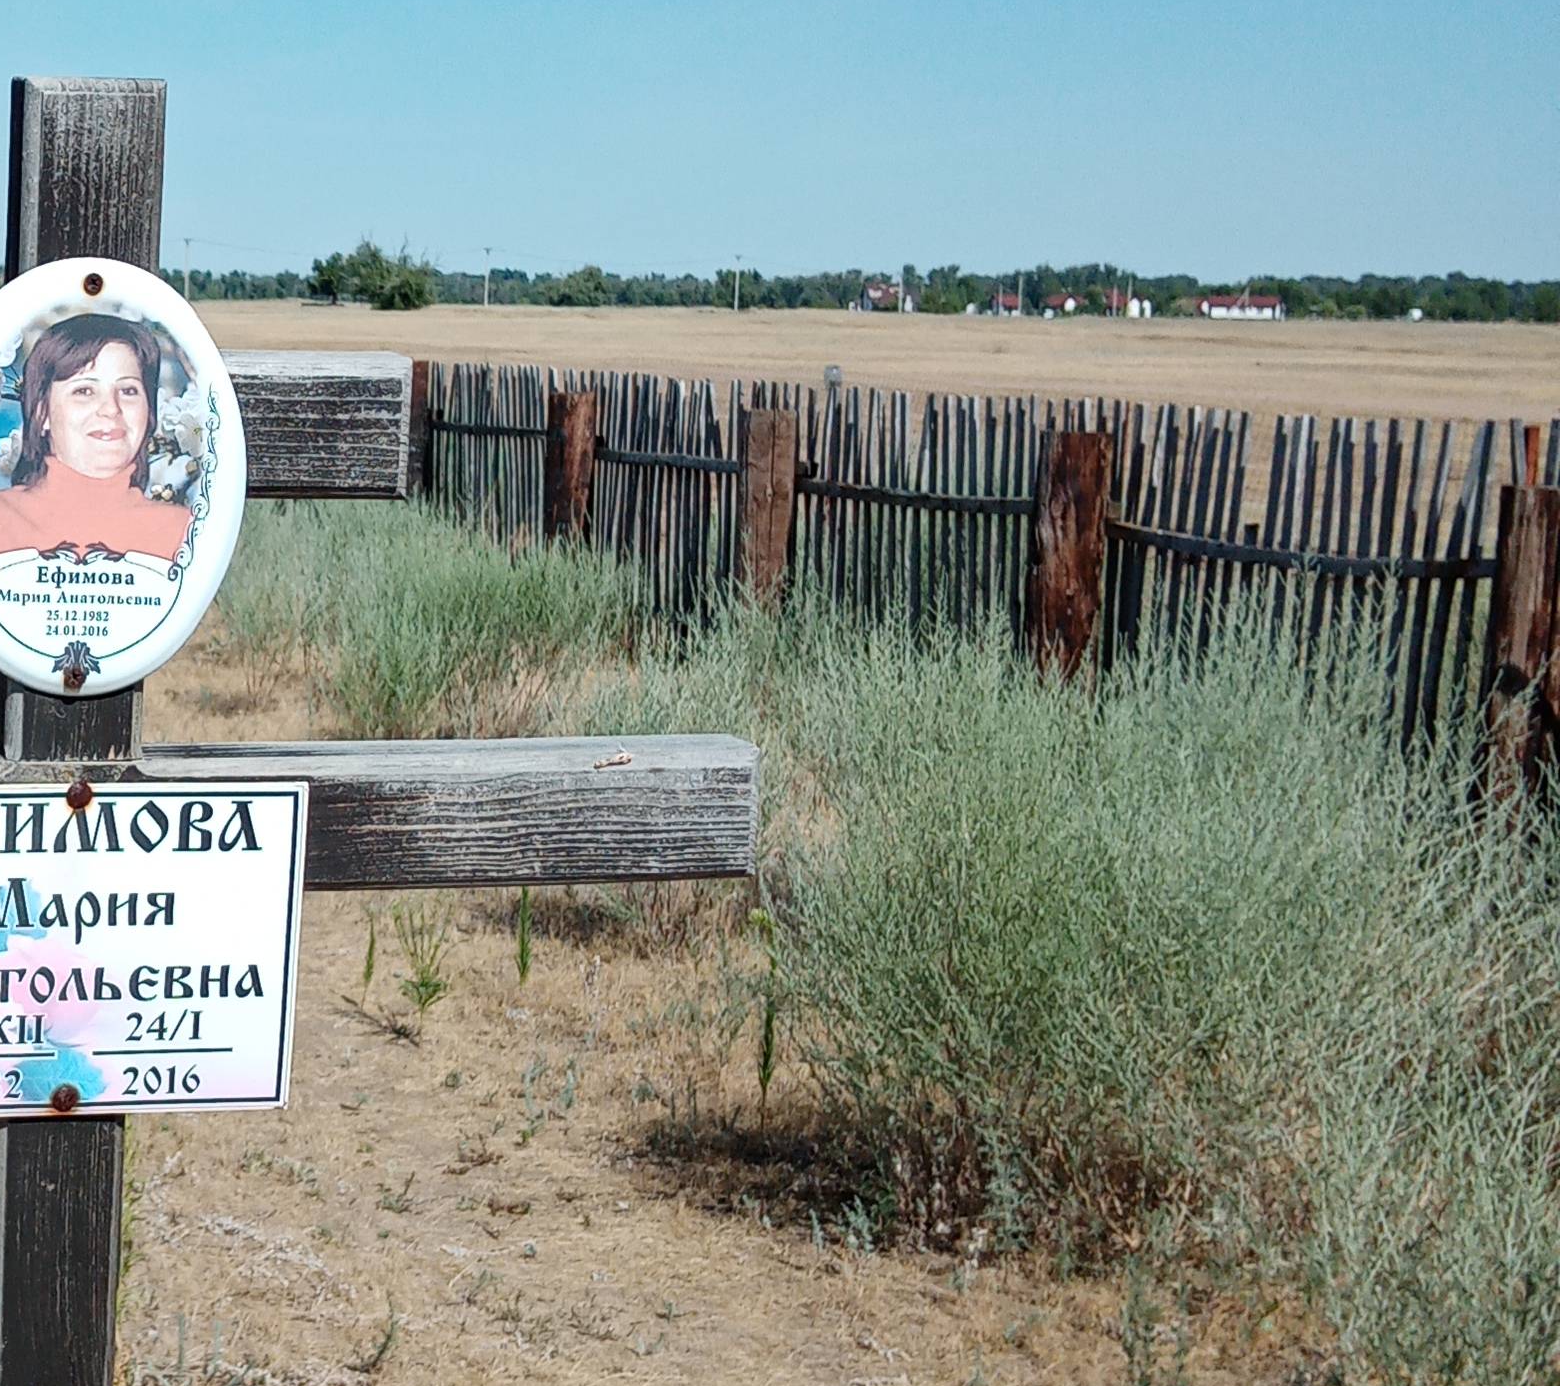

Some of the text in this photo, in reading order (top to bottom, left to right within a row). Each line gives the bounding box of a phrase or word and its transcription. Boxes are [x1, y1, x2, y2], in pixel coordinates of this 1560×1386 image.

[36, 566, 135, 588] Ефимова
[57, 591, 161, 606] Анатольевна
[46, 610, 109, 621] 25.12.1982
[46, 626, 108, 636] 24.01.2016
[122, 1064, 200, 1097] 2016
